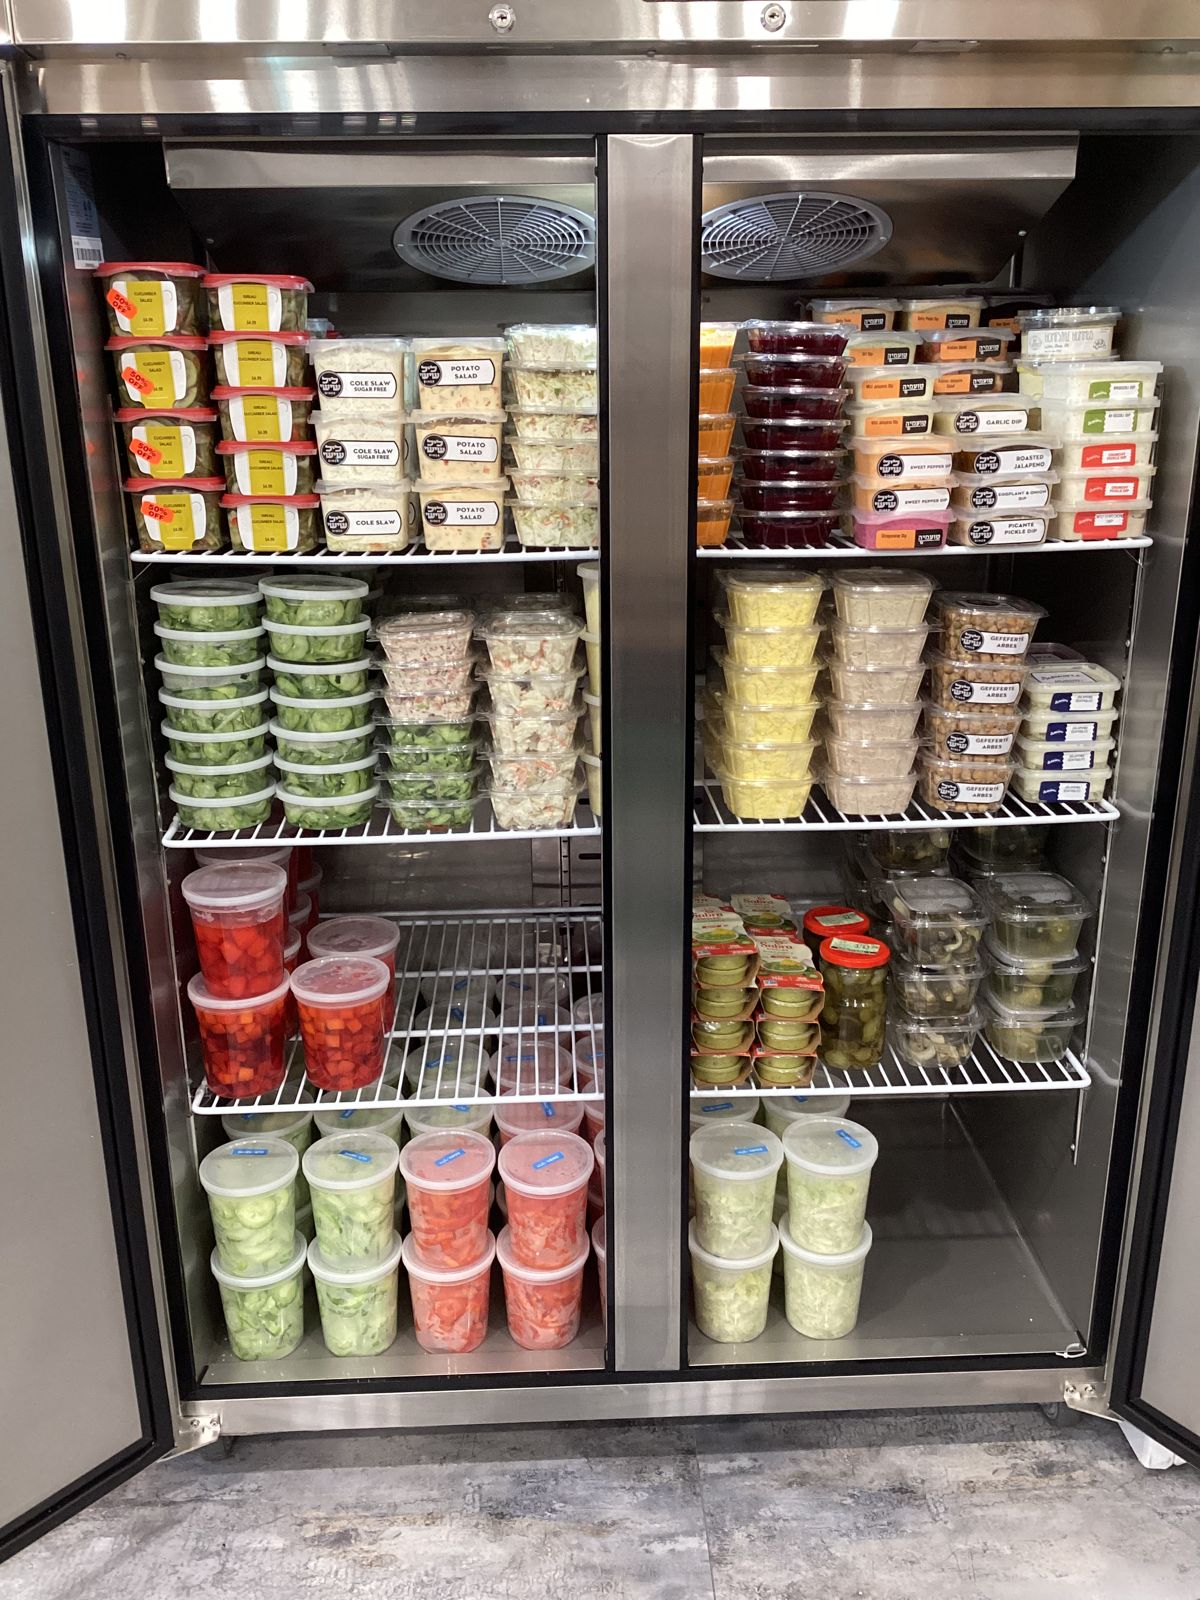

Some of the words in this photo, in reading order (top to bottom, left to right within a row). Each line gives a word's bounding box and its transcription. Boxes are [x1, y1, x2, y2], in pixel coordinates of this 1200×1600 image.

[112, 301, 127, 313] OFF
[114, 294, 131, 311] 50%
[128, 378, 143, 390] OFF
[129, 371, 147, 388] 50%
[137, 443, 156, 457] 50%
[137, 449, 152, 461] OFF
[1015, 454, 1044, 462] ROASTED
[1014, 461, 1045, 470] JALAPENO
[148, 504, 168, 516] 50%
[148, 511, 165, 520] OFF
[760, 942, 793, 952] Sabra
